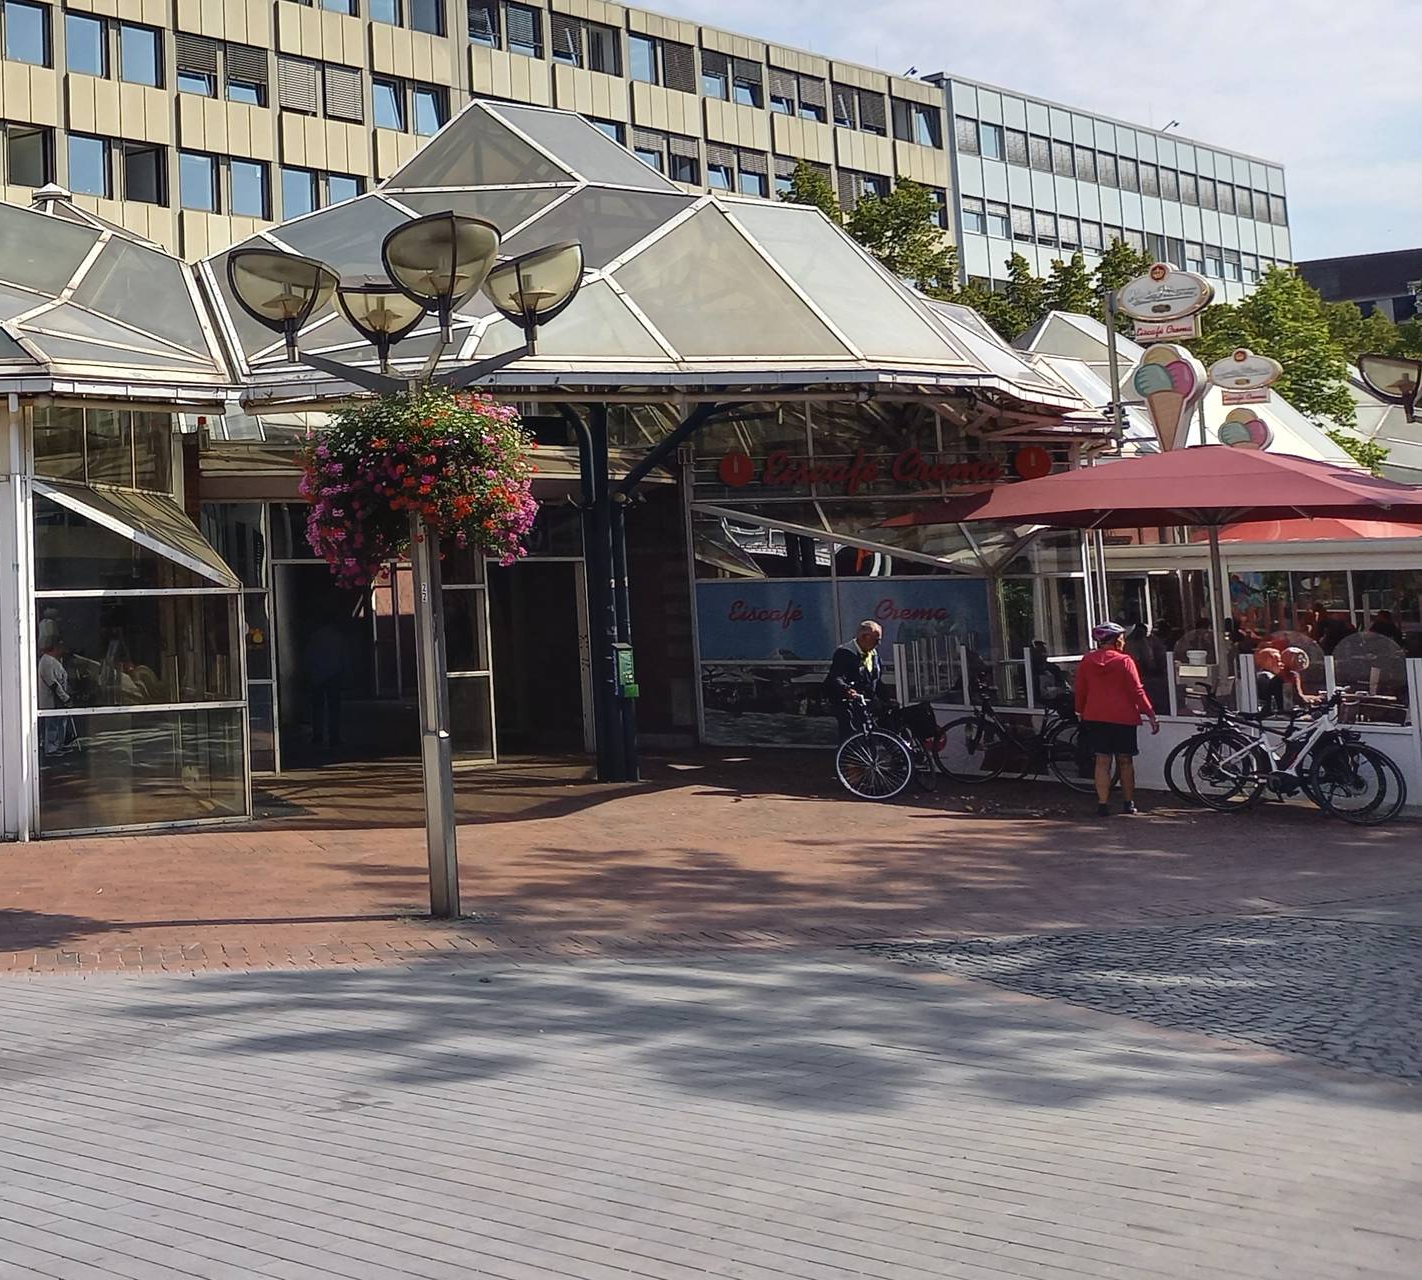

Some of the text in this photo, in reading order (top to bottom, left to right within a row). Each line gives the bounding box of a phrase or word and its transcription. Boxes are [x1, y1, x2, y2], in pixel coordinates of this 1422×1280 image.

[893, 448, 1003, 483] Crema
[728, 599, 949, 629] Eiscafé Crema
